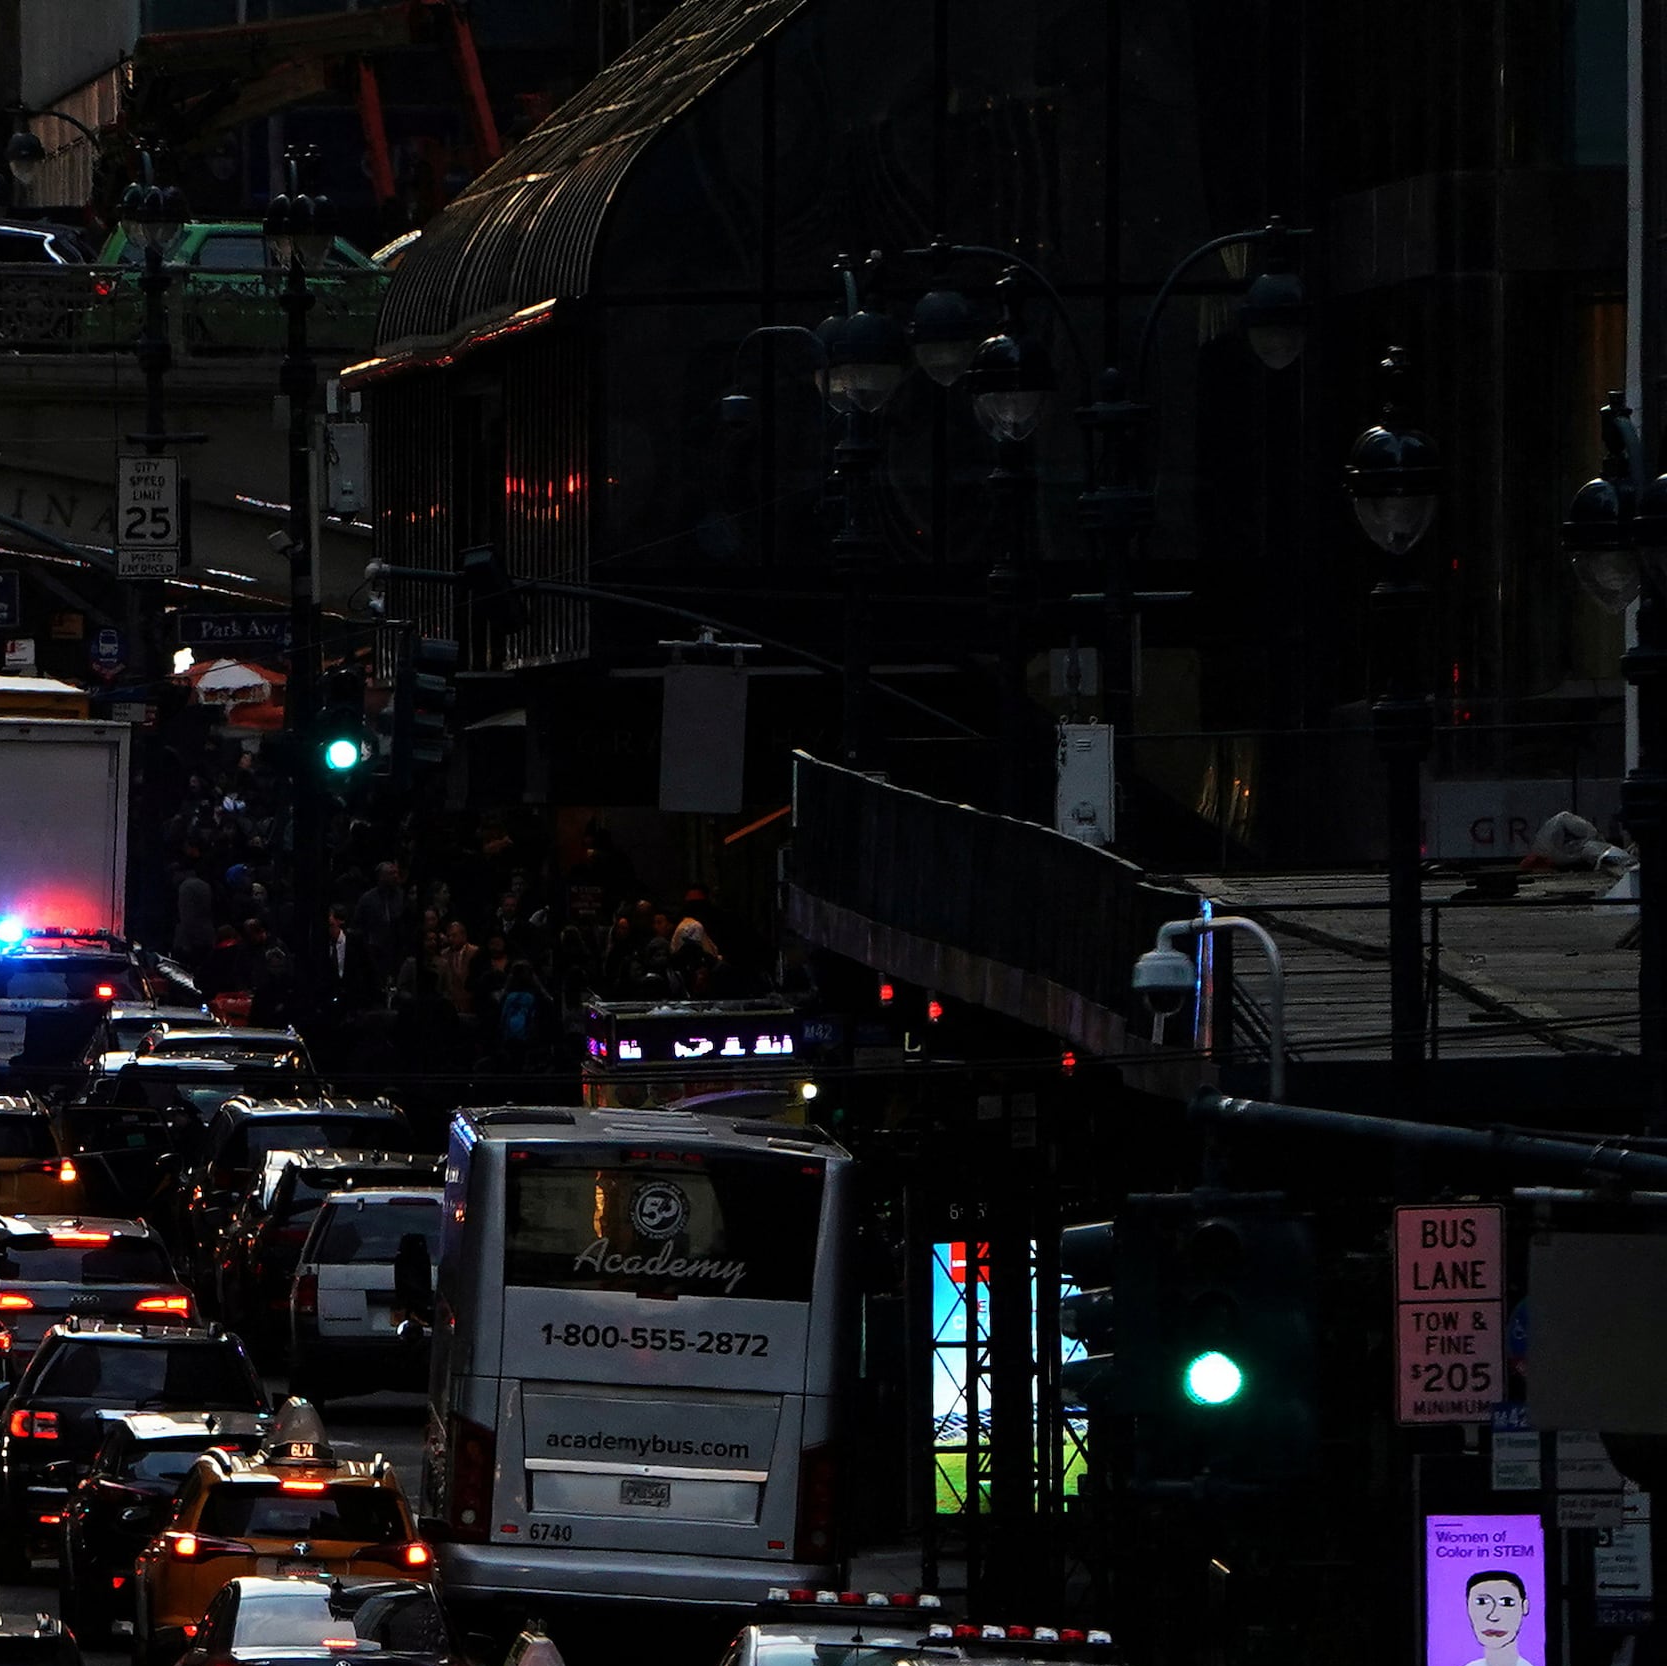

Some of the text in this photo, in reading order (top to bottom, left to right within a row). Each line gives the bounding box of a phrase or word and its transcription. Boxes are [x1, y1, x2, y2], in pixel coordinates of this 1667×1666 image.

[134, 461, 159, 473] CITY
[129, 475, 166, 487] SPEED
[132, 489, 162, 501] LIMIT
[124, 507, 171, 540] 25
[200, 621, 243, 640] Park
[577, 727, 660, 753] GRA
[1421, 1218, 1477, 1250] BUS
[572, 1237, 748, 1294] Academy
[1413, 1260, 1486, 1291] LANE
[1411, 1311, 1488, 1333] TOW &
[540, 1322, 769, 1357] 1-800-555-2872
[1425, 1336, 1476, 1355] FINE
[1410, 1362, 1491, 1393] $205
[1413, 1399, 1492, 1416] MINIMUM
[290, 1443, 314, 1457] 6L74
[545, 1430, 750, 1459] academybus.com
[529, 1523, 573, 1542] 6740
[1435, 1530, 1507, 1543] Women of
[1435, 1545, 1534, 1558] Color in STEM
